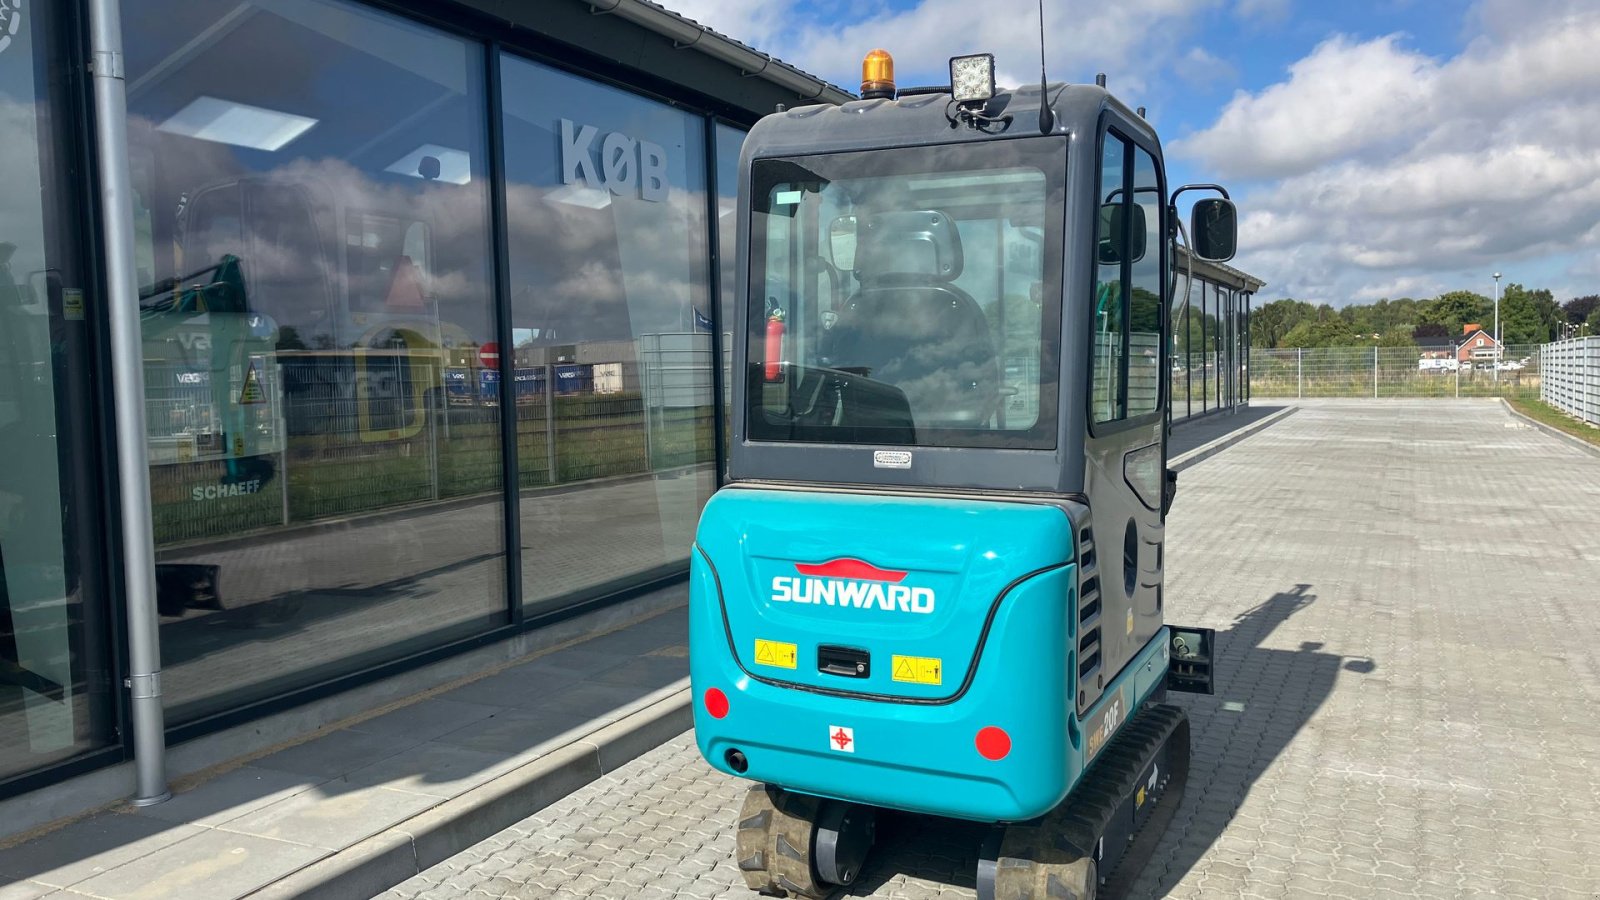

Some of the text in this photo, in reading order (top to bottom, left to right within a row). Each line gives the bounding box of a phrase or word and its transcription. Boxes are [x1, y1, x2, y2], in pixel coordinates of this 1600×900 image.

[561, 118, 670, 202] KØB
[192, 479, 260, 501] SCHAEFF
[771, 576, 935, 614] SUNWARD
